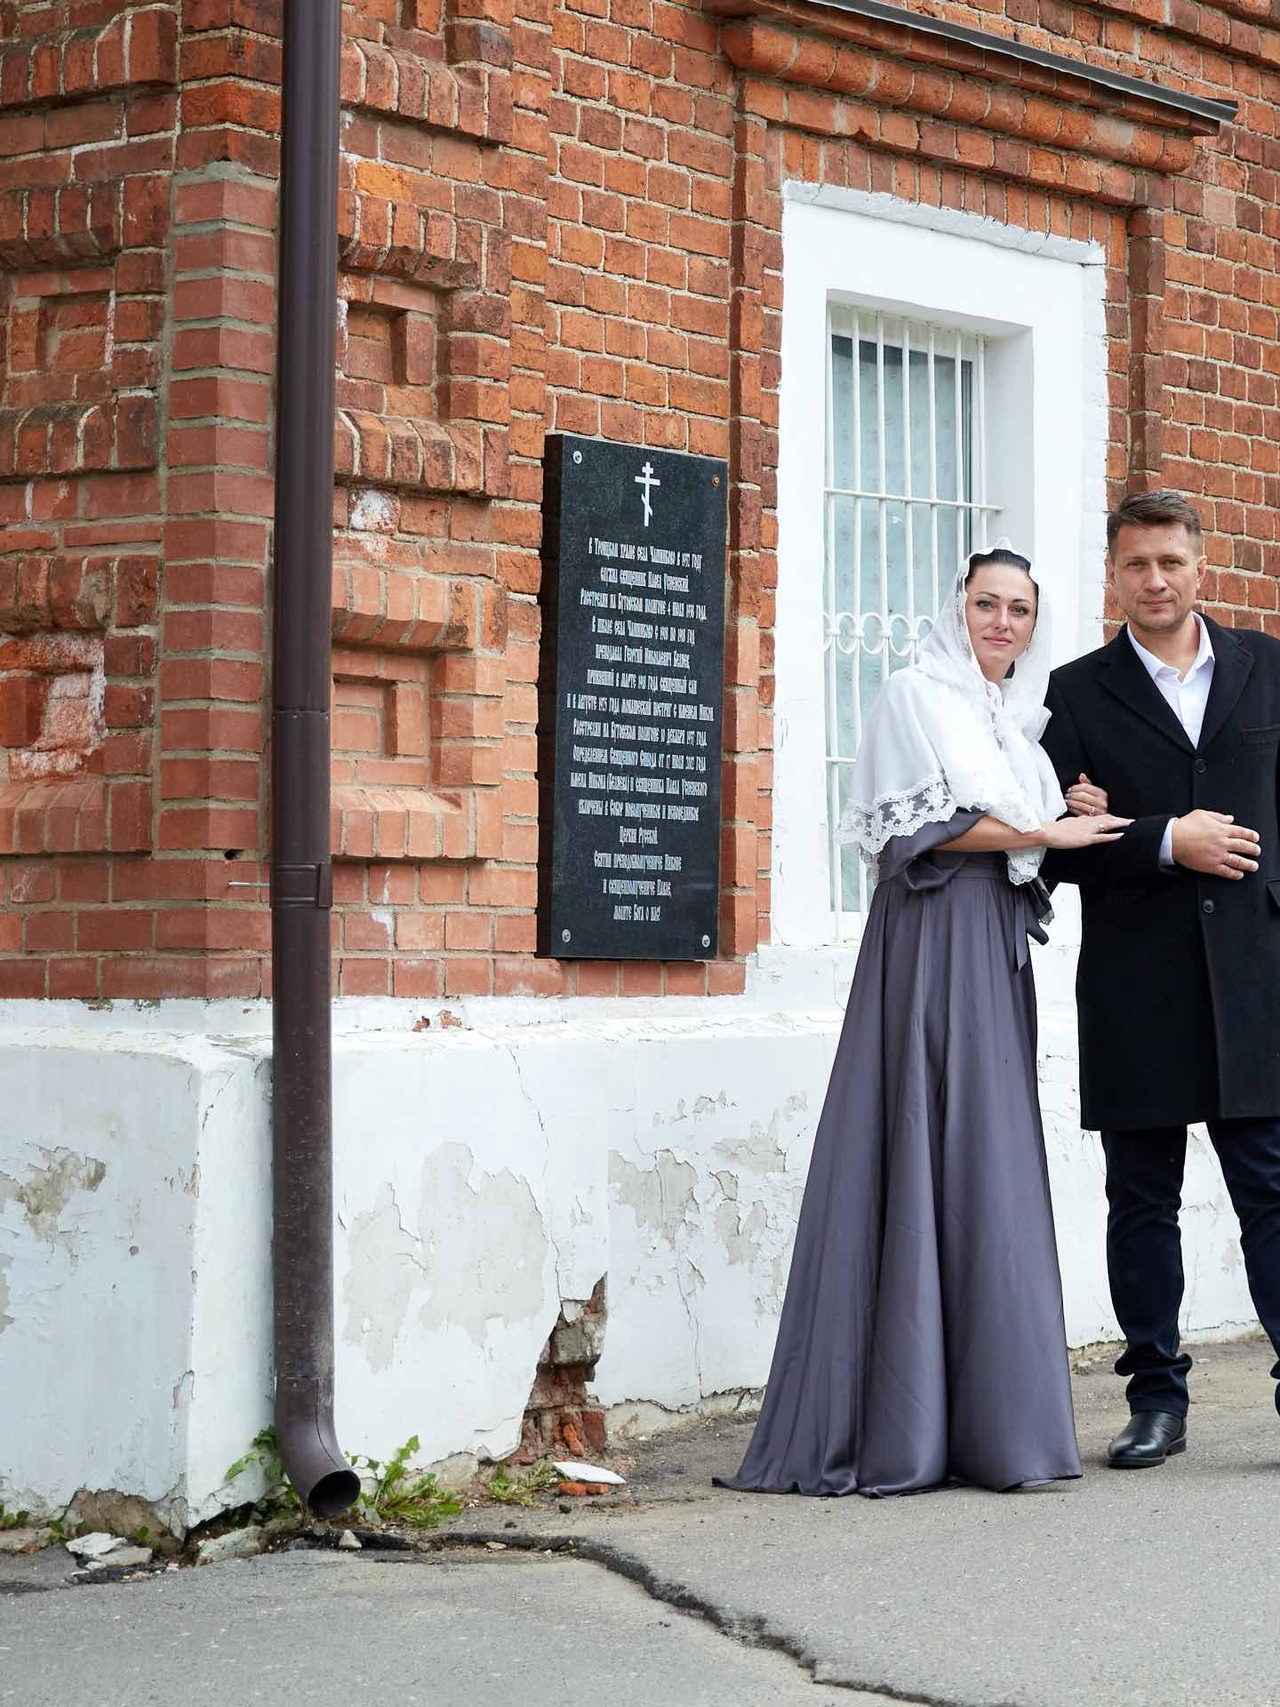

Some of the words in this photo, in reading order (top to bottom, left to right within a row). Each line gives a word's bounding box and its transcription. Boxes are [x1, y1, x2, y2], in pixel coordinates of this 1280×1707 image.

[594, 538, 618, 560] Троицком
[620, 544, 635, 560] храме
[637, 546, 648, 561] села
[600, 567, 618, 586] служил
[620, 569, 646, 589] священник
[648, 571, 662, 589] Павел
[580, 588, 608, 608] Расстрелян
[618, 593, 643, 614] Бутовском
[645, 599, 666, 615] полигоне
[672, 602, 684, 617] июля
[597, 618, 612, 634] школе
[614, 620, 625, 635] села
[595, 644, 622, 662] преподавал
[624, 645, 643, 663] Георгий
[645, 648, 672, 667] Николаевич
[587, 669, 614, 686] принявший
[620, 673, 637, 688] марте
[648, 676, 658, 693] года
[659, 676, 687, 695] священный
[689, 680, 697, 694] сан
[577, 694, 597, 714] августе
[609, 697, 620, 715] года
[621, 698, 651, 715] монашеский
[653, 702, 672, 717] постриг
[678, 704, 697, 719] именем
[573, 718, 601, 737] Расстрелян
[611, 721, 637, 742] Бутовском
[638, 726, 659, 742] полигоне
[667, 729, 685, 745] декабря
[573, 744, 608, 764] Определением
[610, 747, 638, 768] Священного
[640, 750, 657, 769] Синода
[696, 756, 706, 773] года
[570, 772, 587, 788] имена
[589, 772, 606, 789] Никона
[607, 773, 629, 793] (Беляева)
[635, 777, 664, 793] священника
[666, 778, 679, 794] Павла
[681, 779, 708, 799] Успенского
[578, 799, 604, 815] включены
[610, 799, 623, 816] Собор
[624, 802, 661, 821] новомучеников
[667, 805, 699, 823] исповедников
[619, 826, 637, 846] Церкви
[613, 905, 632, 920] молите
[633, 904, 644, 920] Бога
